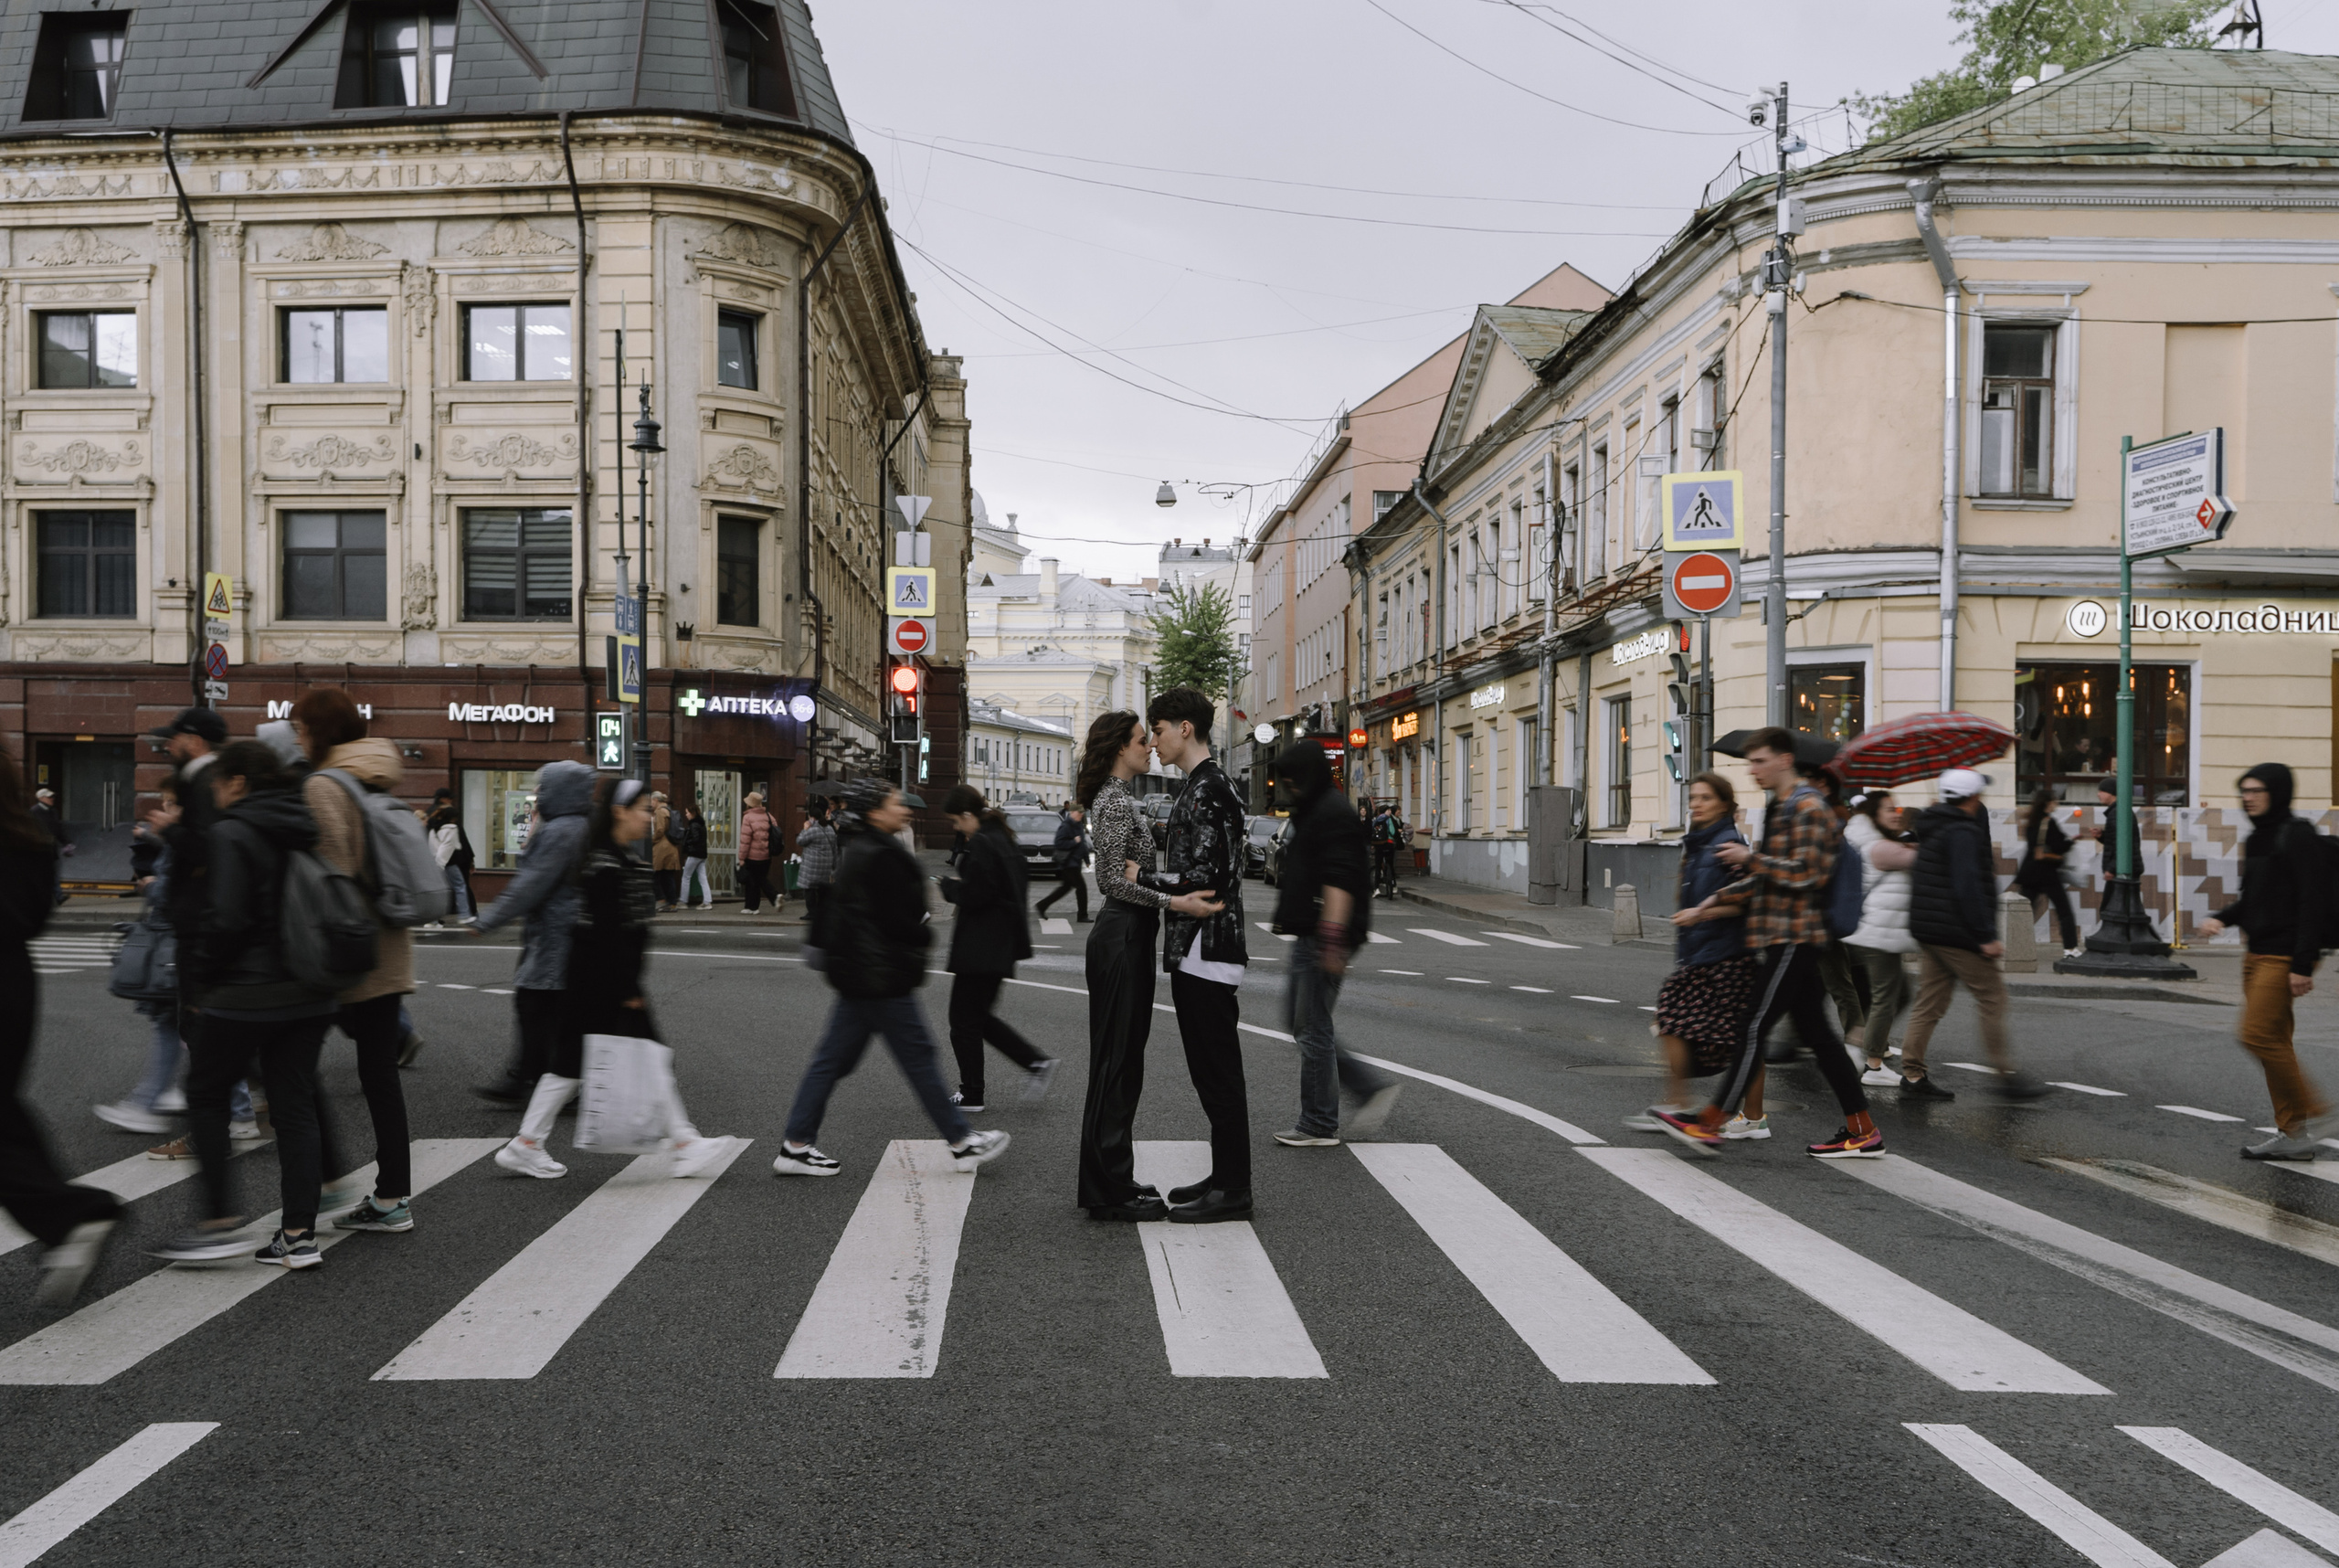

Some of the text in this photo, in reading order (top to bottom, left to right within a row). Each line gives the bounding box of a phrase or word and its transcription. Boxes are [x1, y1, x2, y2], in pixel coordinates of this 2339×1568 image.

[2185, 474, 2203, 485] ЦЕНТР
[2166, 484, 2204, 500] СПОРТИВНОЕ
[707, 695, 788, 715] АПТЕКА
[905, 696, 916, 713] 7
[600, 718, 620, 737] 04
